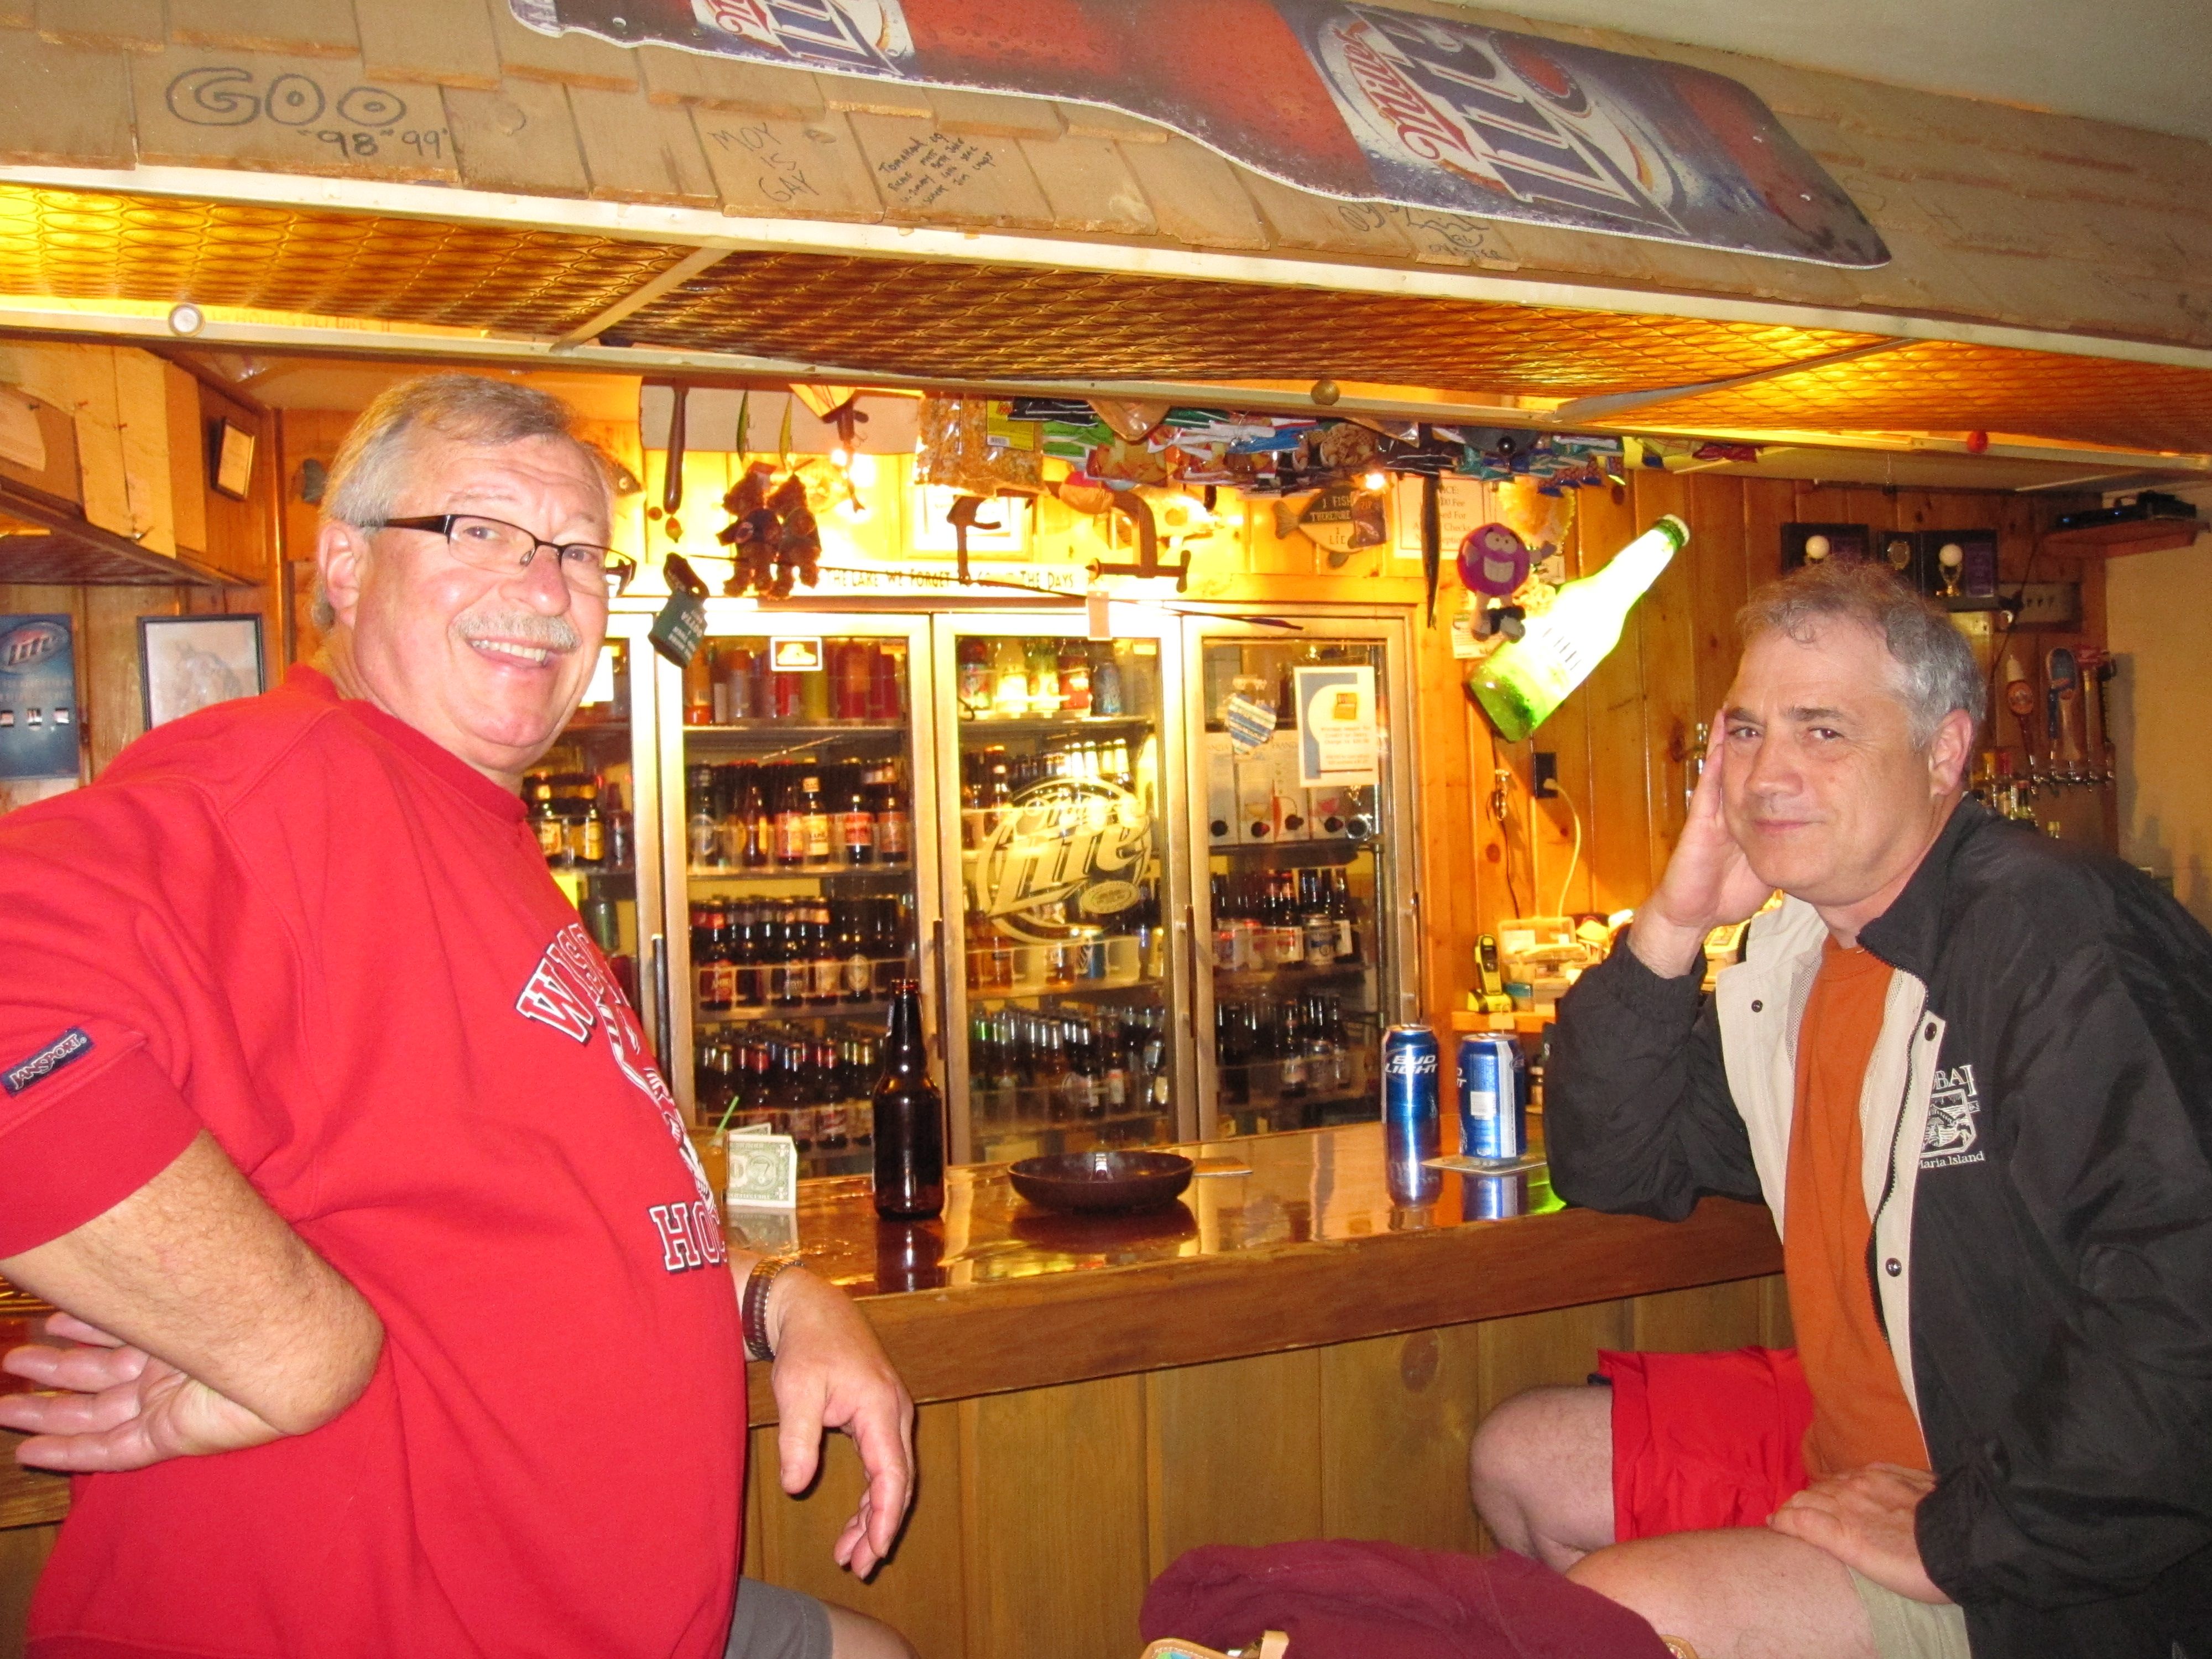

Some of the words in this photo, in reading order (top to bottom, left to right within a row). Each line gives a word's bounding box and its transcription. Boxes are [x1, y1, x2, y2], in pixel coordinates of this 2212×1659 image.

[1332, 27, 1480, 162] Miller
[1344, 4, 1689, 236] Lite
[758, 170, 820, 204] GAY
[1329, 535, 1346, 545] LIE
[1047, 572, 1073, 590] DAYS
[987, 820, 1148, 918] Lite
[1384, 1063, 1438, 1074] LIGHT
[1392, 1055, 1436, 1065] BUD
[1947, 1150, 1985, 1165] Island
